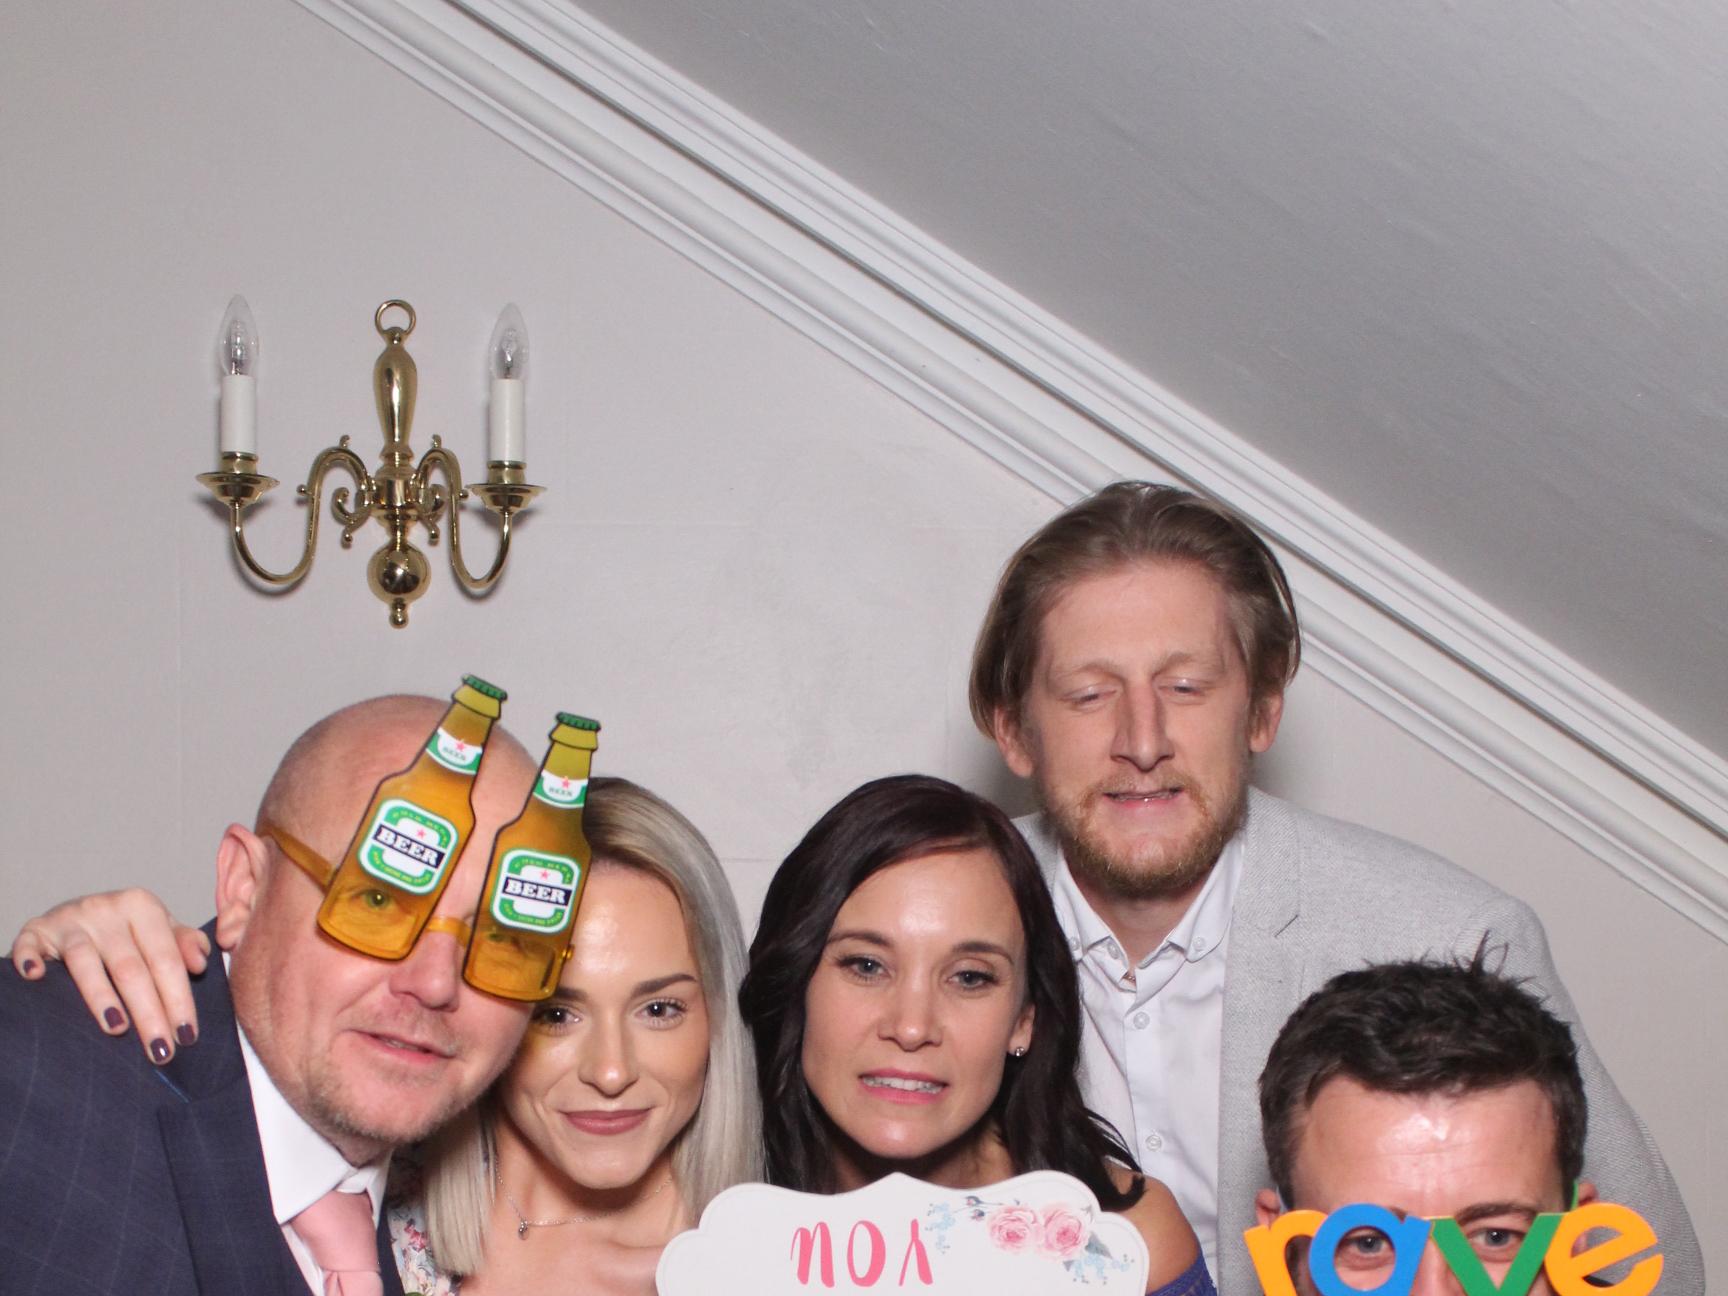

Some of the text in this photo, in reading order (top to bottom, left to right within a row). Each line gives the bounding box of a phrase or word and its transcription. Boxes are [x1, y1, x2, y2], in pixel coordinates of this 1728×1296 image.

[376, 825, 438, 866] BEER
[505, 878, 566, 904] BEER
[789, 1219, 934, 1288] YOU
